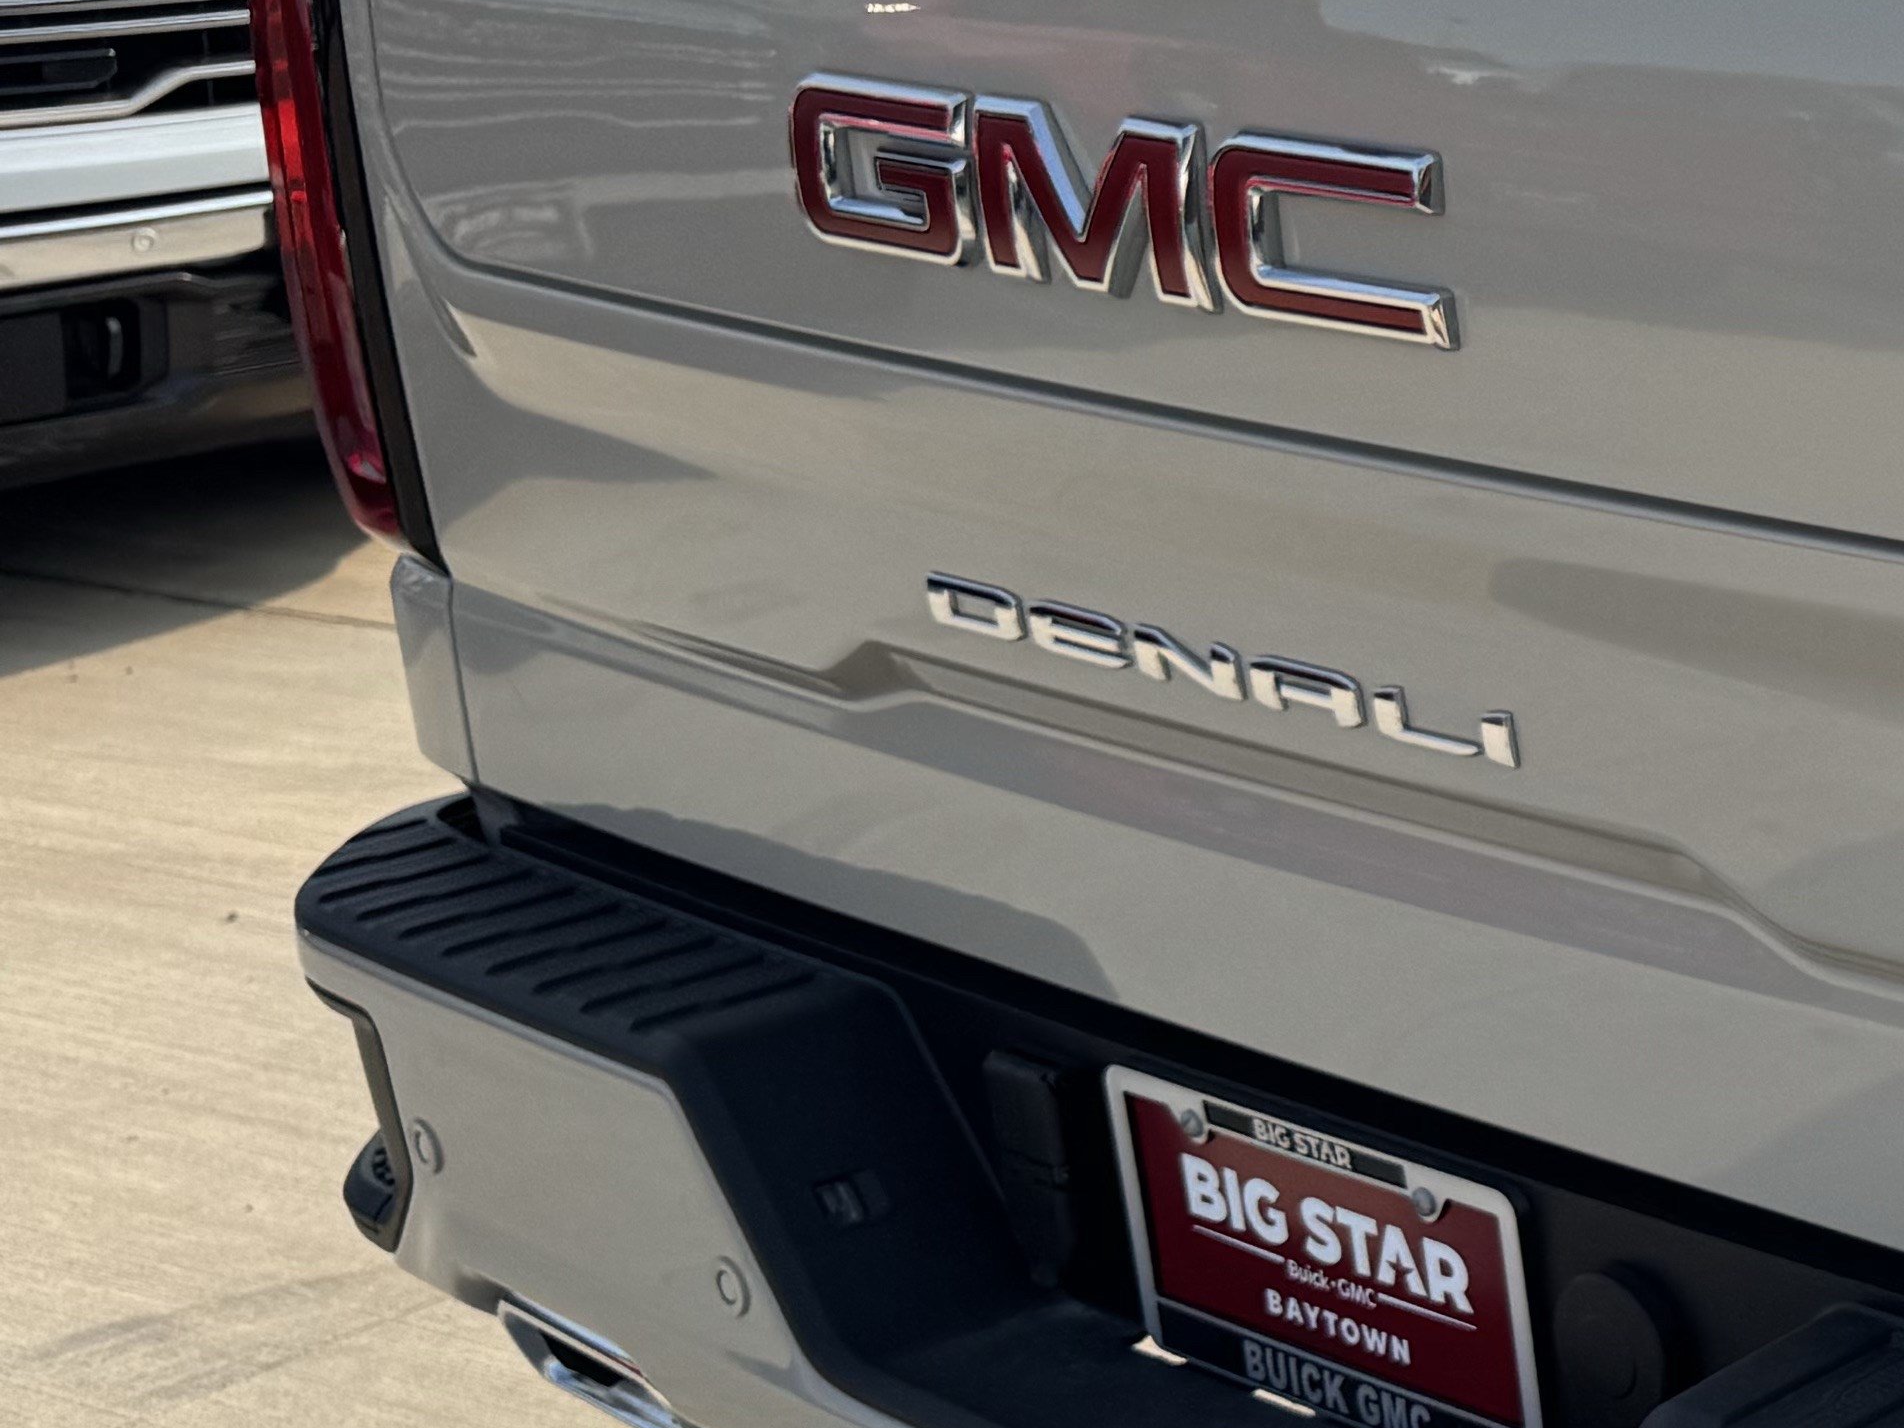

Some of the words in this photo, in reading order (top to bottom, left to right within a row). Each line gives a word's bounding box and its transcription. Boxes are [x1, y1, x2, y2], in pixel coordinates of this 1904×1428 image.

[789, 72, 1460, 350] GMC
[926, 571, 1520, 769] DENALI
[1252, 1117, 1292, 1149] BIG
[1292, 1132, 1353, 1169] STAR
[1179, 1153, 1289, 1247] BIG
[1300, 1196, 1474, 1315] STAR
[1243, 1338, 1350, 1414] BUICK
[1263, 1288, 1411, 1366] BAYTOWN
